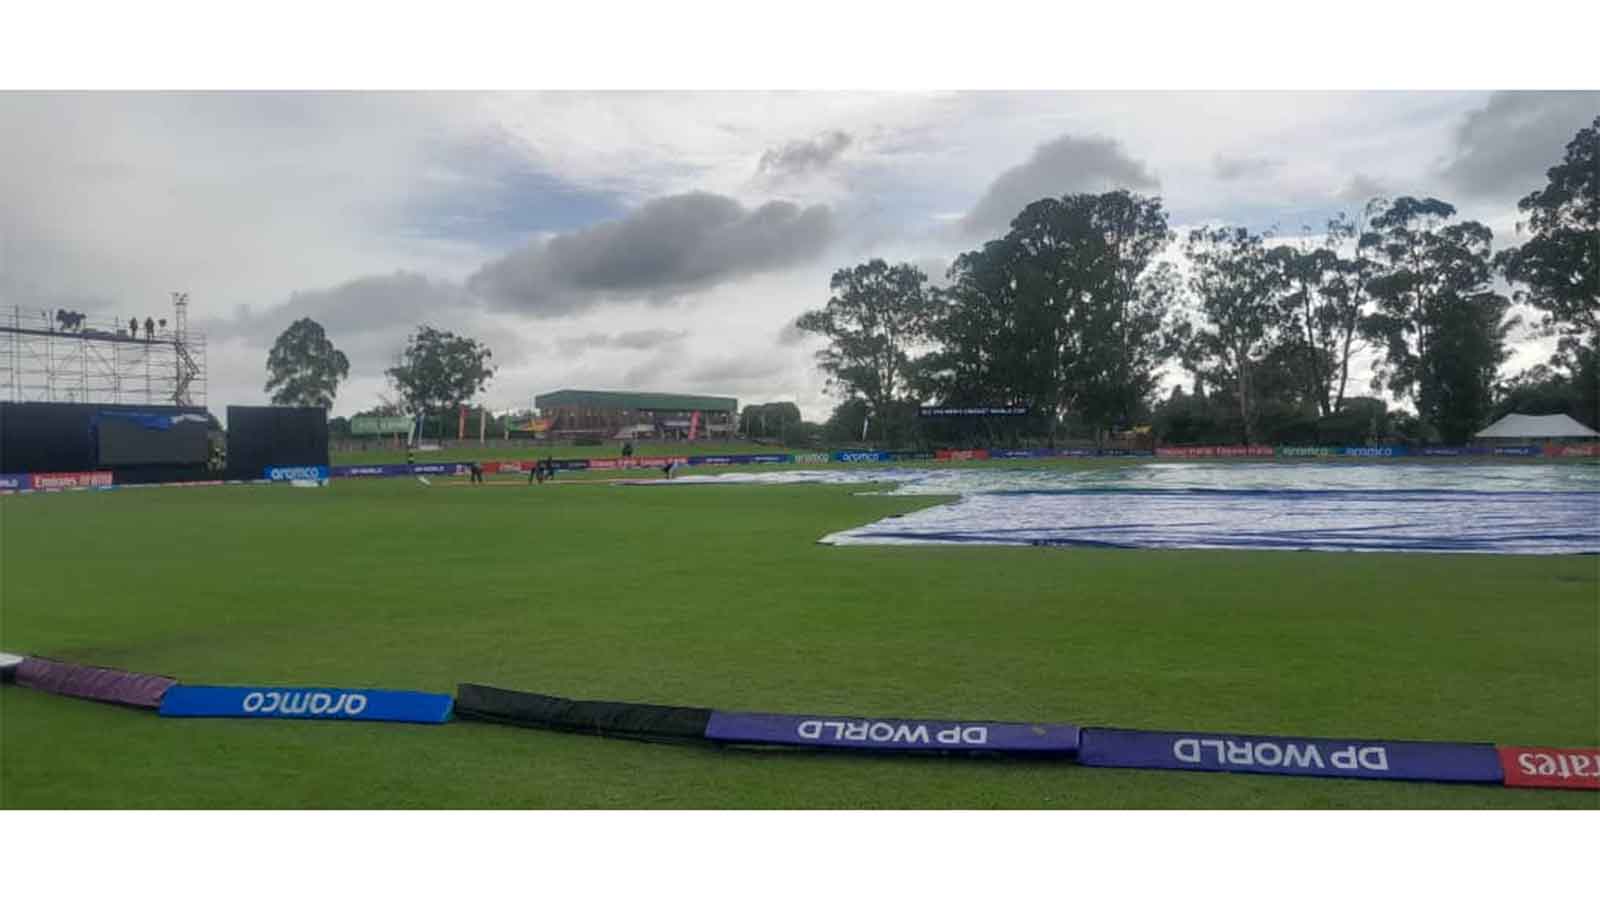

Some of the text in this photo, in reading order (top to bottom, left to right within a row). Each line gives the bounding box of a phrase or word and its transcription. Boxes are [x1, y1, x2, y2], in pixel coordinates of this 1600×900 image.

[271, 467, 319, 480] aramco
[243, 691, 367, 715] aramco
[797, 719, 988, 744] DP WORLD
[1173, 738, 1390, 770] DP WORLD
